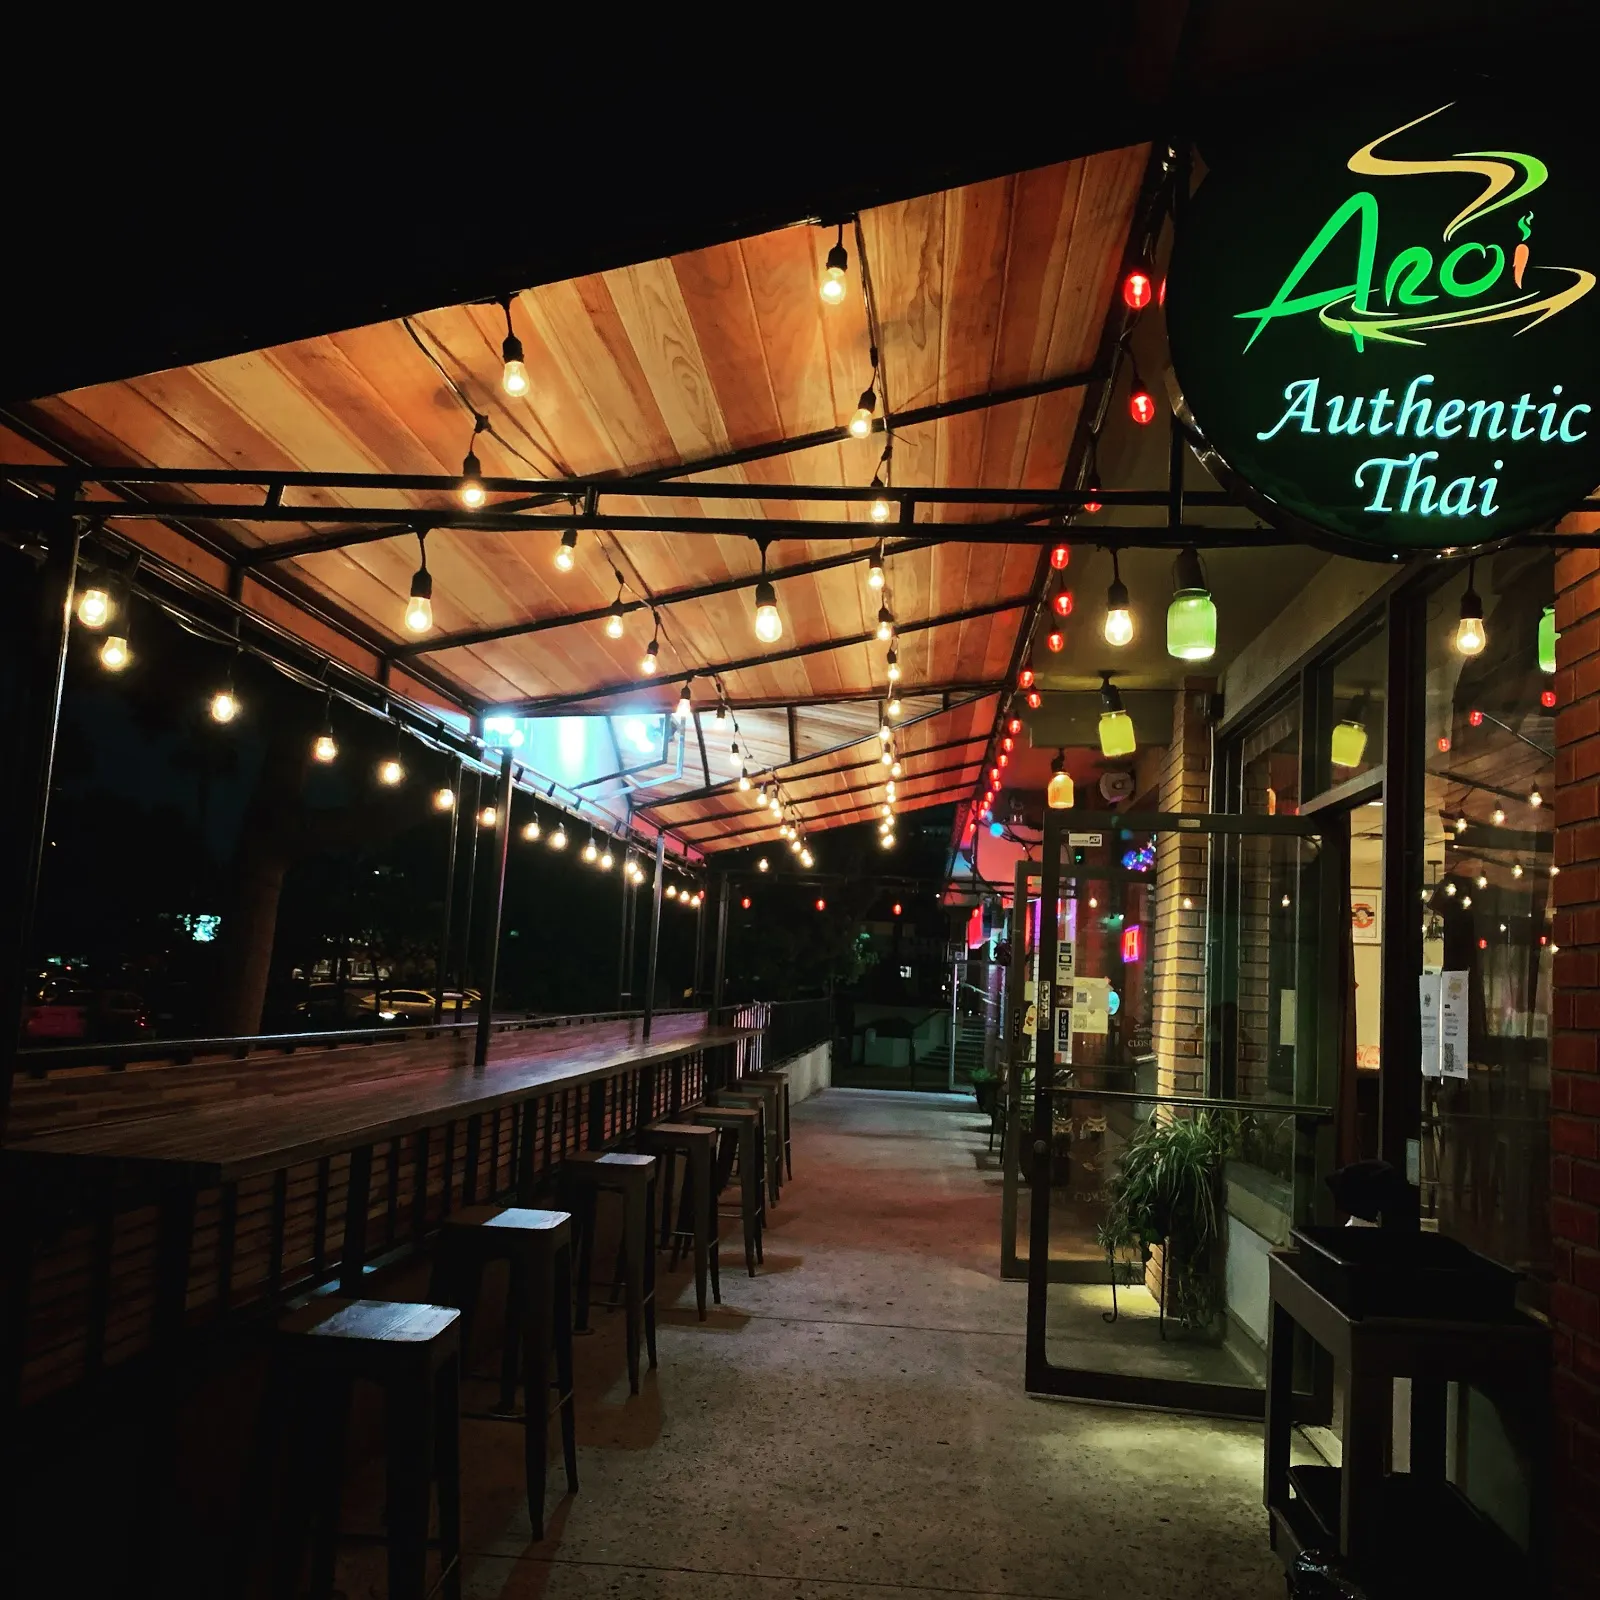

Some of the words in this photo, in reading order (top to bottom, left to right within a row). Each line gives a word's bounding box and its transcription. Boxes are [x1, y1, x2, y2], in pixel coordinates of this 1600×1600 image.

[1256, 374, 1592, 443] Authentic
[1354, 450, 1504, 517] Thai
[1041, 983, 1049, 1018] PUSH
[1060, 1011, 1068, 1038] PUSH
